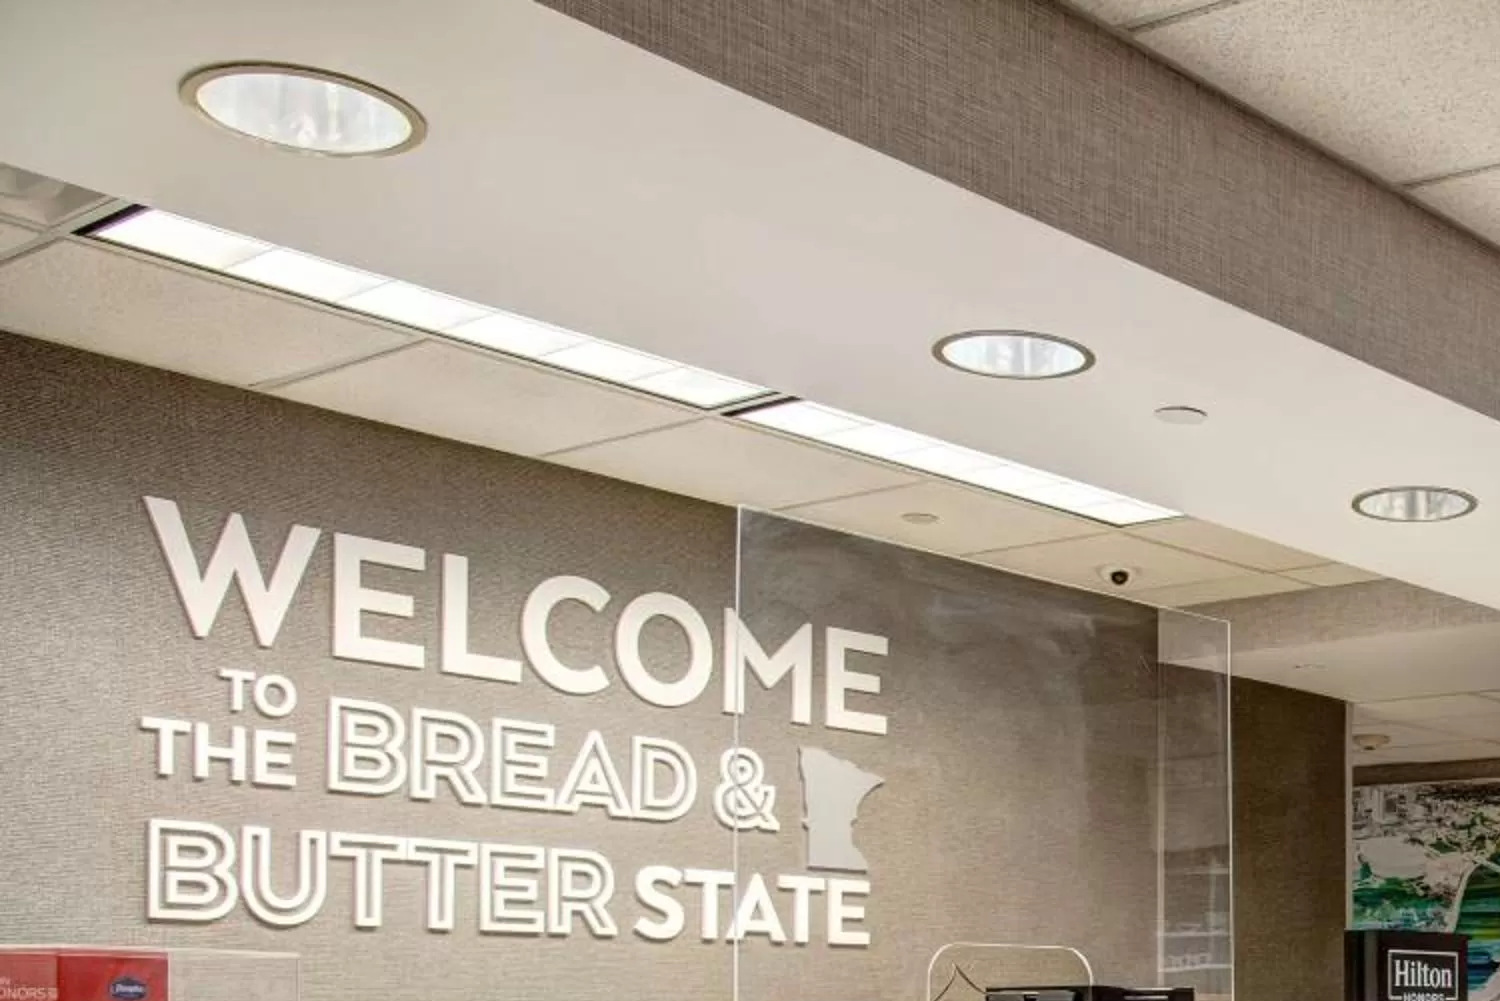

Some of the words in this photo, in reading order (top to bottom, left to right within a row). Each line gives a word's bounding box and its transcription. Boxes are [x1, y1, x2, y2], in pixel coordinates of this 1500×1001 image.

[143, 495, 889, 735] WELCOME
[219, 667, 297, 719] TO
[140, 716, 298, 788] THE
[327, 696, 697, 822] BREAD
[713, 748, 780, 832] &
[146, 819, 618, 938] BUTTER
[634, 866, 871, 946] STATE
[1394, 959, 1452, 989] Hilton
